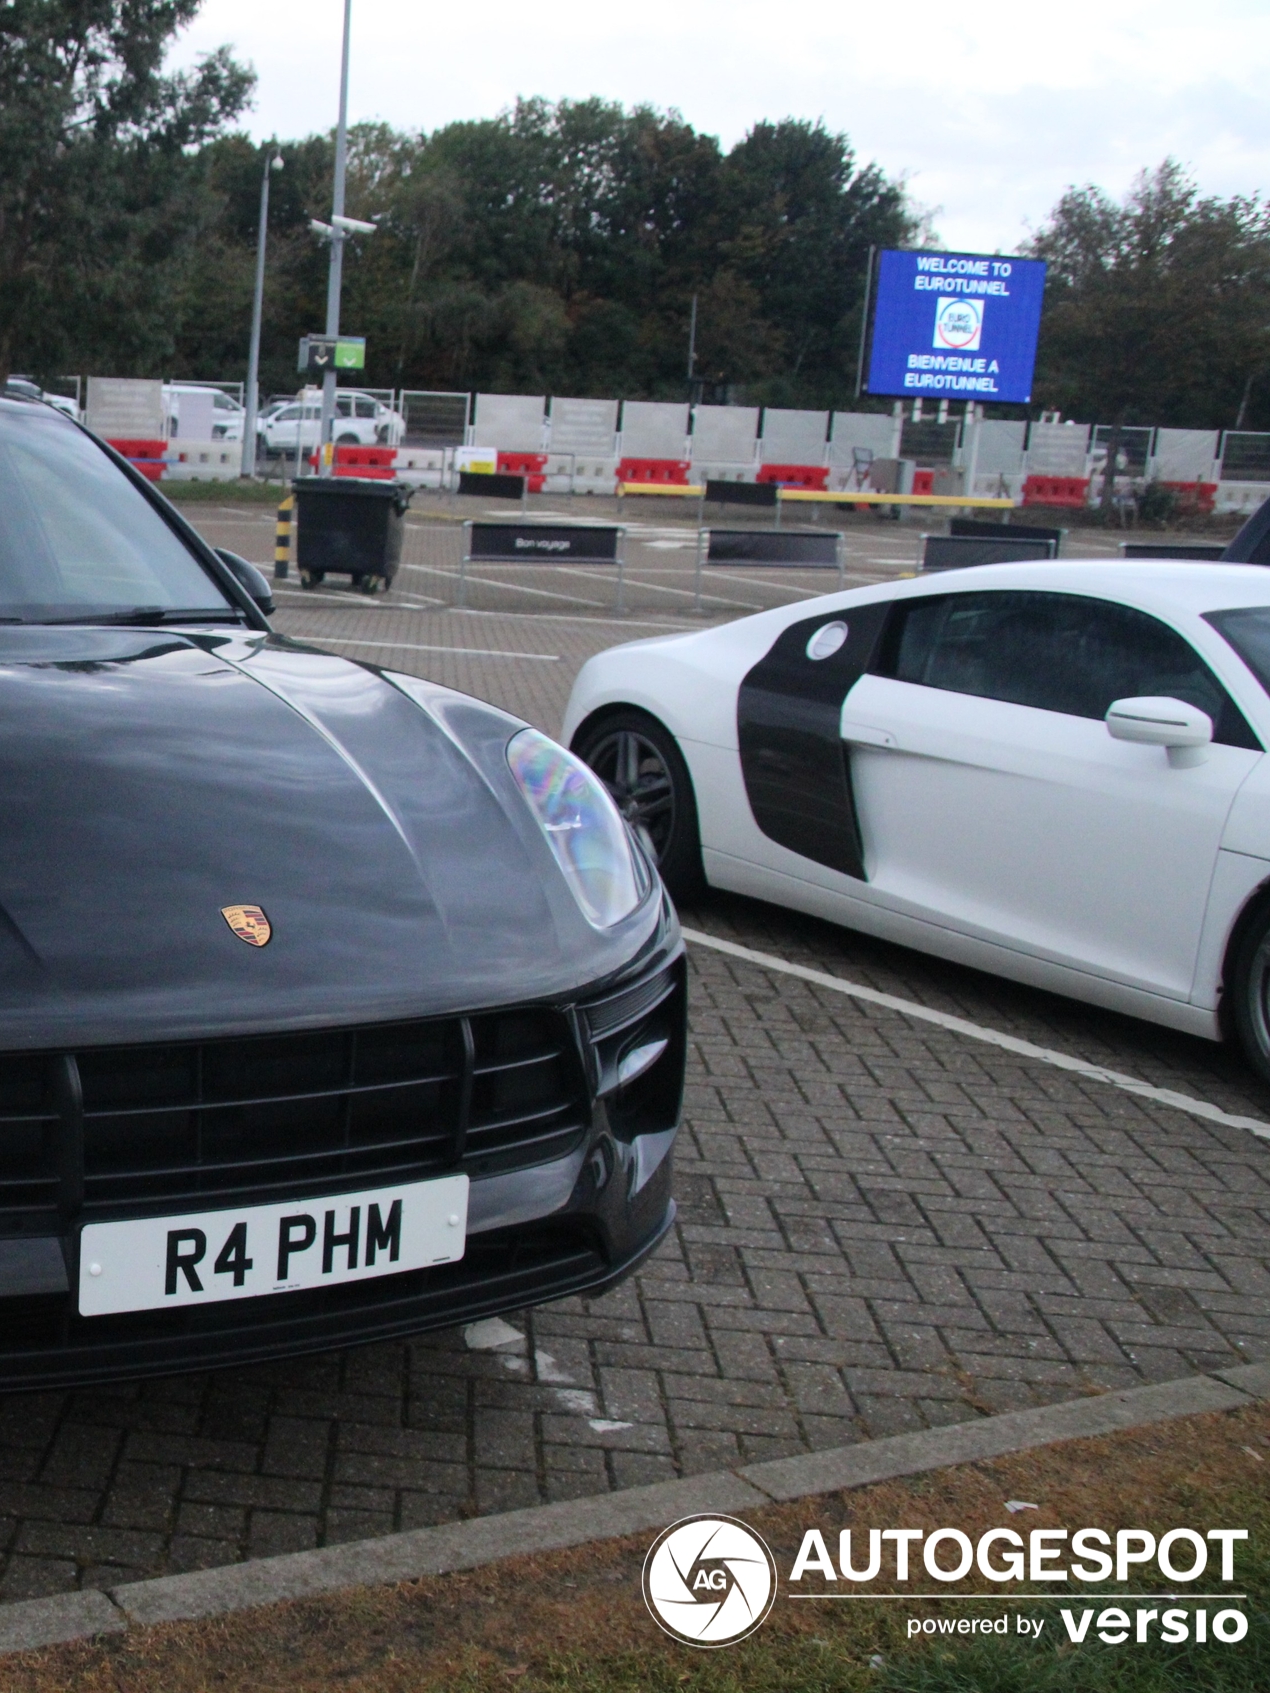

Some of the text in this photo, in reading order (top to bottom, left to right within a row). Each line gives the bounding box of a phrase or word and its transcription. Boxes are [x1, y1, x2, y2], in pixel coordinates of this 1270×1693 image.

[917, 257, 1012, 277] WELCOME TO
[914, 276, 1010, 296] EUROTUNNEL
[948, 313, 971, 323] EURO
[943, 323, 973, 334] TUNNEL
[907, 354, 999, 374] BIENVENUE A
[904, 373, 998, 392] EUROTUNNEL
[165, 1199, 402, 1295] R4 PHM
